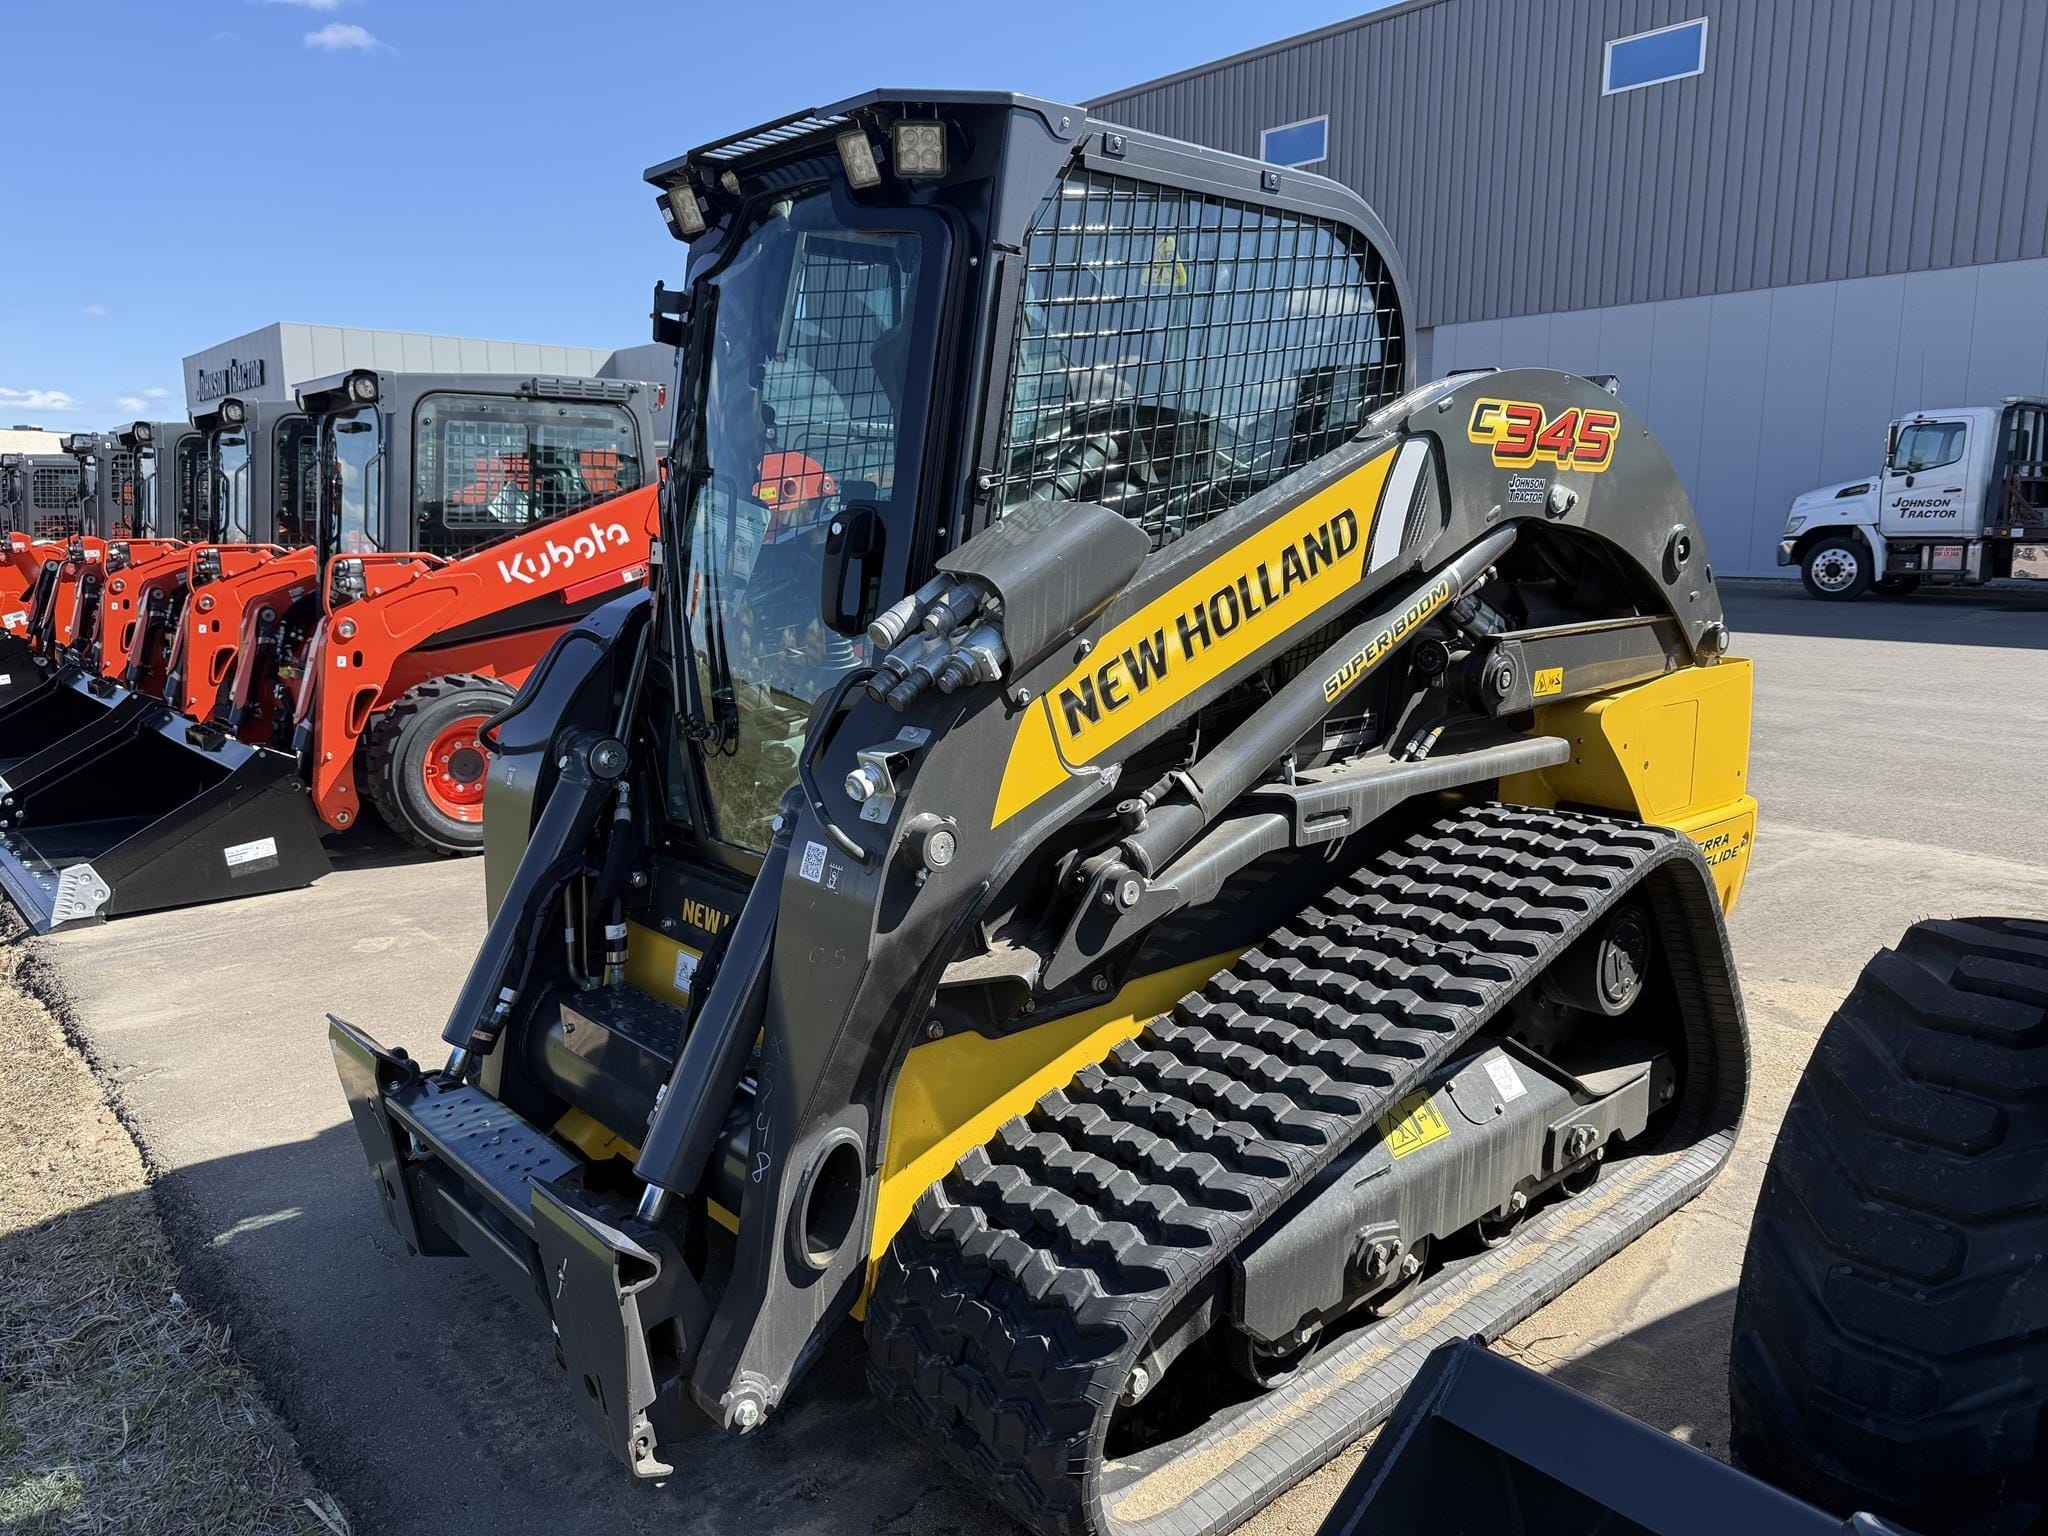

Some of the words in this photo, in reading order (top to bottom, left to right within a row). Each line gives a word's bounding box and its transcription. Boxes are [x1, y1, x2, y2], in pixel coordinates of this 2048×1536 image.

[197, 369, 229, 402] JOHNSON
[228, 359, 265, 393] TRACTOR
[1469, 398, 1620, 471] C345
[1508, 474, 1545, 490] JOHNSON
[1508, 488, 1544, 503] TRACTOR
[1891, 496, 1951, 508] JOHNSON
[1900, 507, 1957, 518] TRACTOR
[496, 522, 631, 584] Kubota
[1058, 626, 1168, 738] NEW
[1175, 507, 1359, 660] HOLLAND
[1323, 629, 1393, 702] SUPER
[1391, 580, 1449, 642] BOOM
[682, 898, 721, 934] NEW
